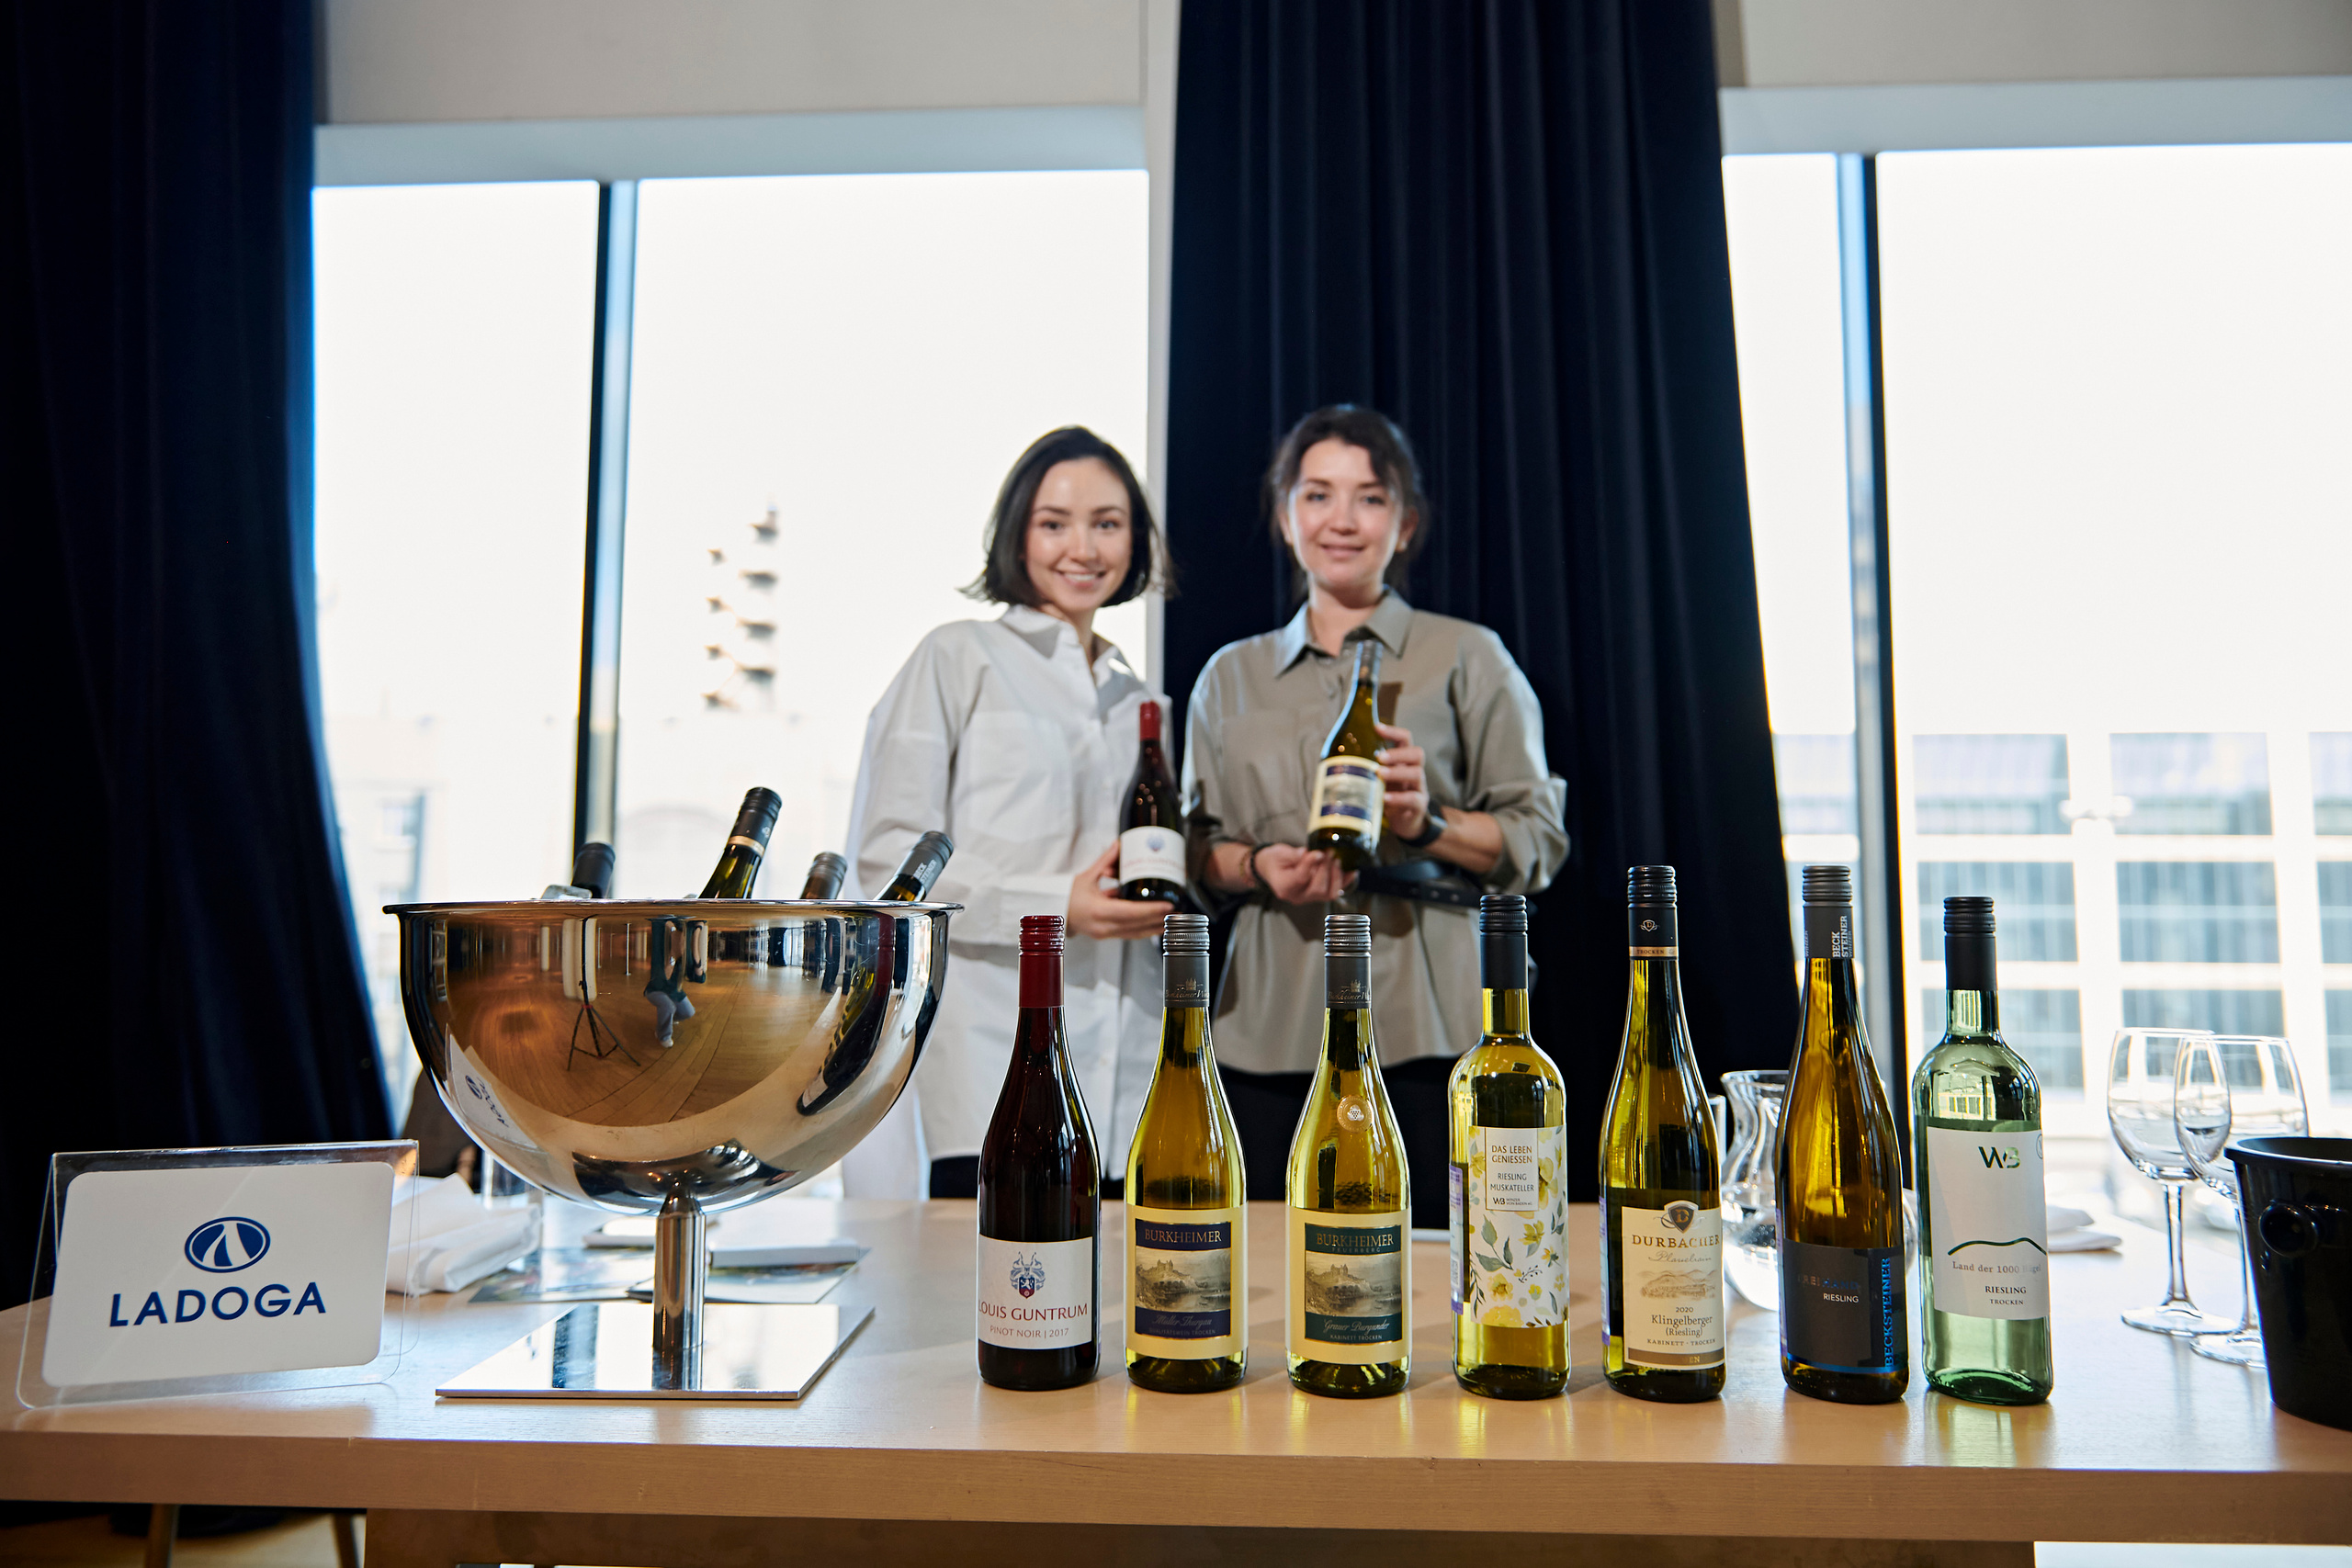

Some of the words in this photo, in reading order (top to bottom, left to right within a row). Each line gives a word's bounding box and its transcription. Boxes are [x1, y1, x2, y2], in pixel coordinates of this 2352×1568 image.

[1840, 915, 1849, 958] STEINER
[1831, 931, 1841, 958] BECK
[1491, 1145, 1507, 1154] DAS
[1510, 1145, 1532, 1154] LEBEN
[1491, 1155, 1532, 1164] GENIESSEN
[1498, 1172, 1527, 1180] RIESLING
[1490, 1183, 1534, 1191] MUSKATELLER
[1145, 1228, 1222, 1244] BURKHEIMER
[1317, 1233, 1394, 1247] BURKHEIMER
[1632, 1235, 1720, 1248] DURBACHER
[1952, 1260, 1974, 1271] Land
[1978, 1264, 1993, 1273] der
[1997, 1265, 2019, 1273] 1000
[1984, 1286, 2027, 1294] RIESLING
[109, 1281, 326, 1327] LADOGA
[1823, 1292, 1859, 1303] RIESLING
[978, 1299, 1007, 1319] LOUIS
[1011, 1303, 1088, 1322] GUNTRUM
[1882, 1257, 1894, 1367] BECKSTEINER
[1651, 1314, 1713, 1328] Klingelberger
[989, 1325, 1014, 1337] PINOT
[1016, 1329, 1041, 1338] NOIR
[1049, 1327, 1069, 1337] 2017
[1665, 1326, 1703, 1338] (Riesling)
